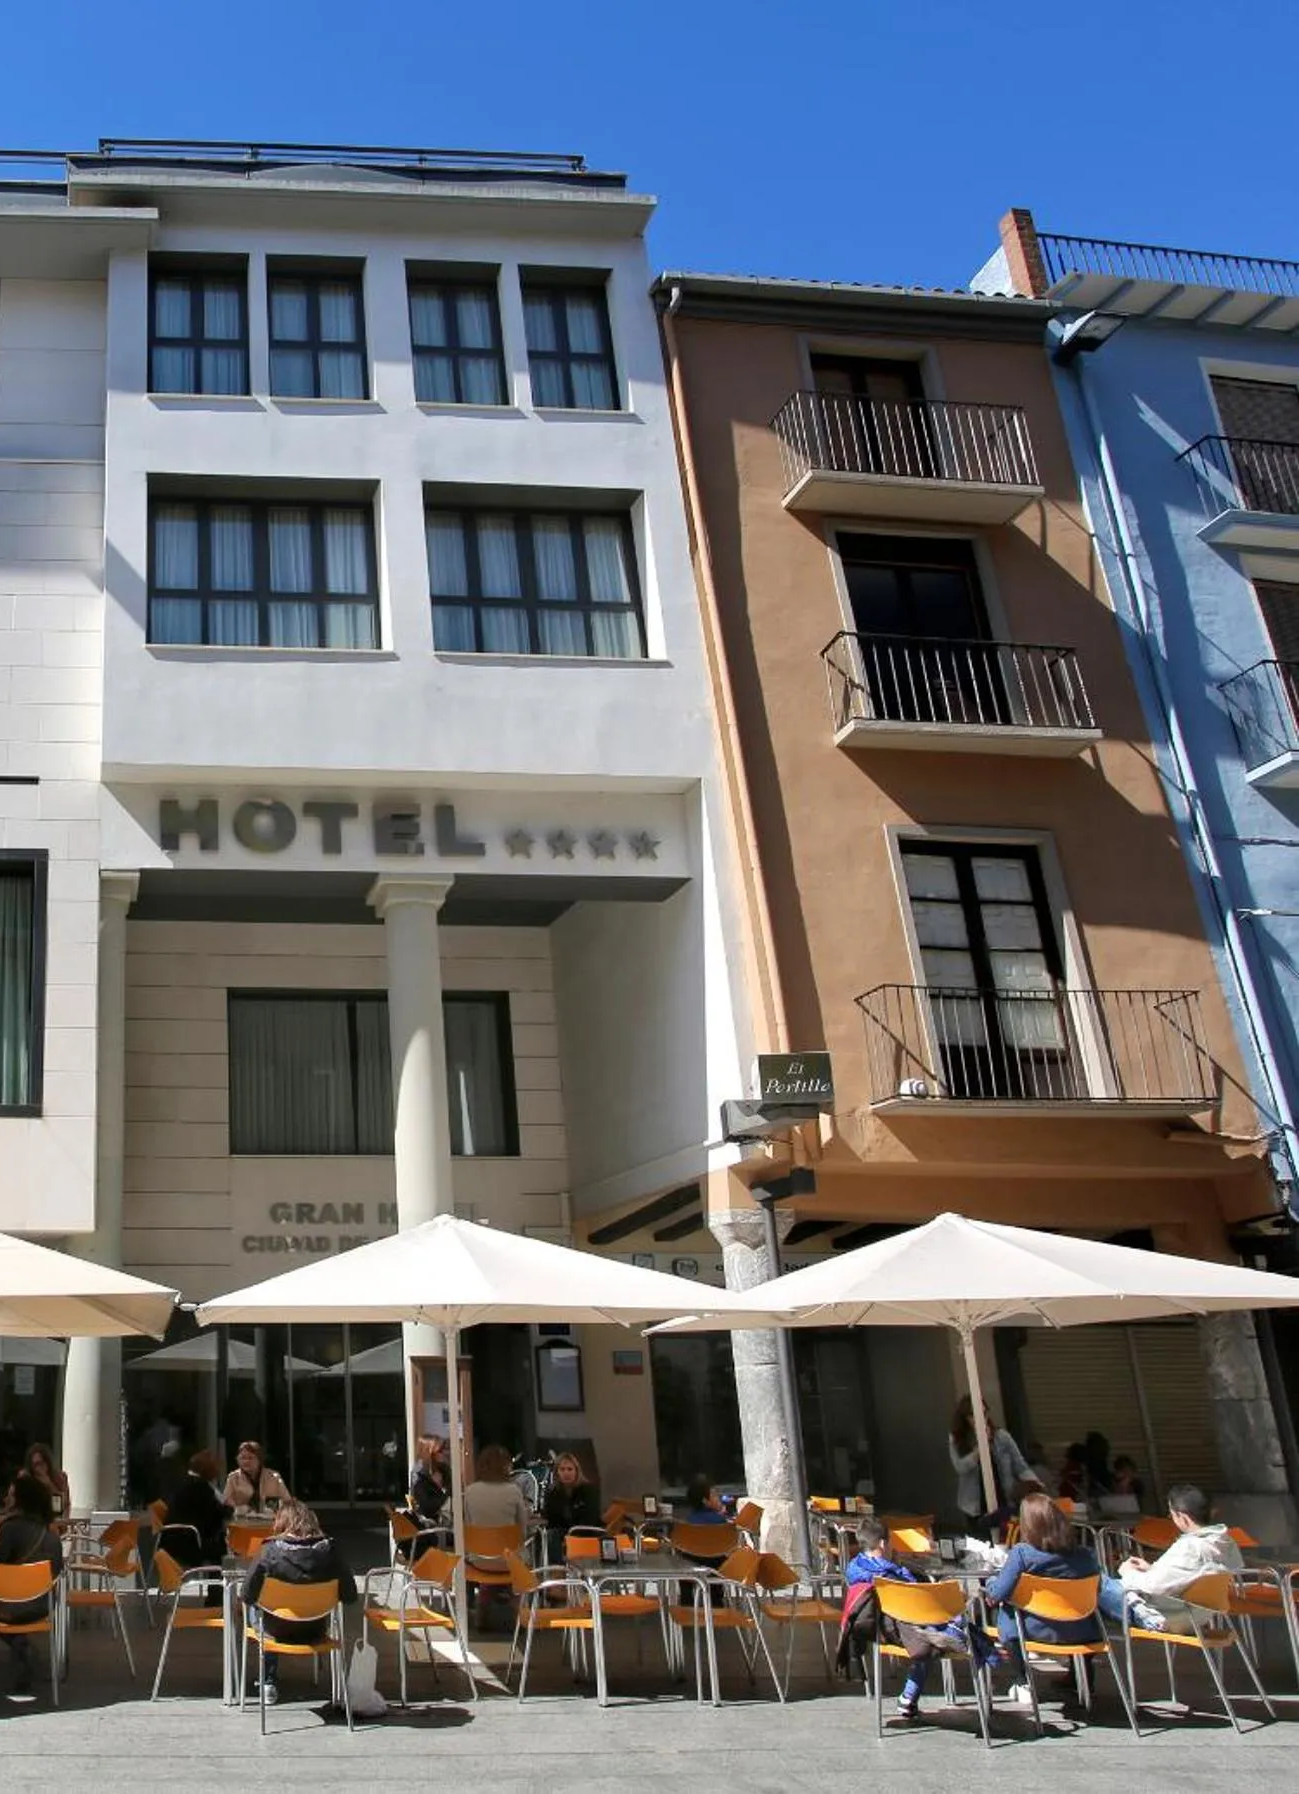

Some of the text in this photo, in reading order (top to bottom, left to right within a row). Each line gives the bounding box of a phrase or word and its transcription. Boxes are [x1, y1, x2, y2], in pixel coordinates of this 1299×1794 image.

[158, 797, 486, 858] HOTEL
[268, 1202, 365, 1225] GRAN
[241, 1235, 331, 1253] CIUDAD
